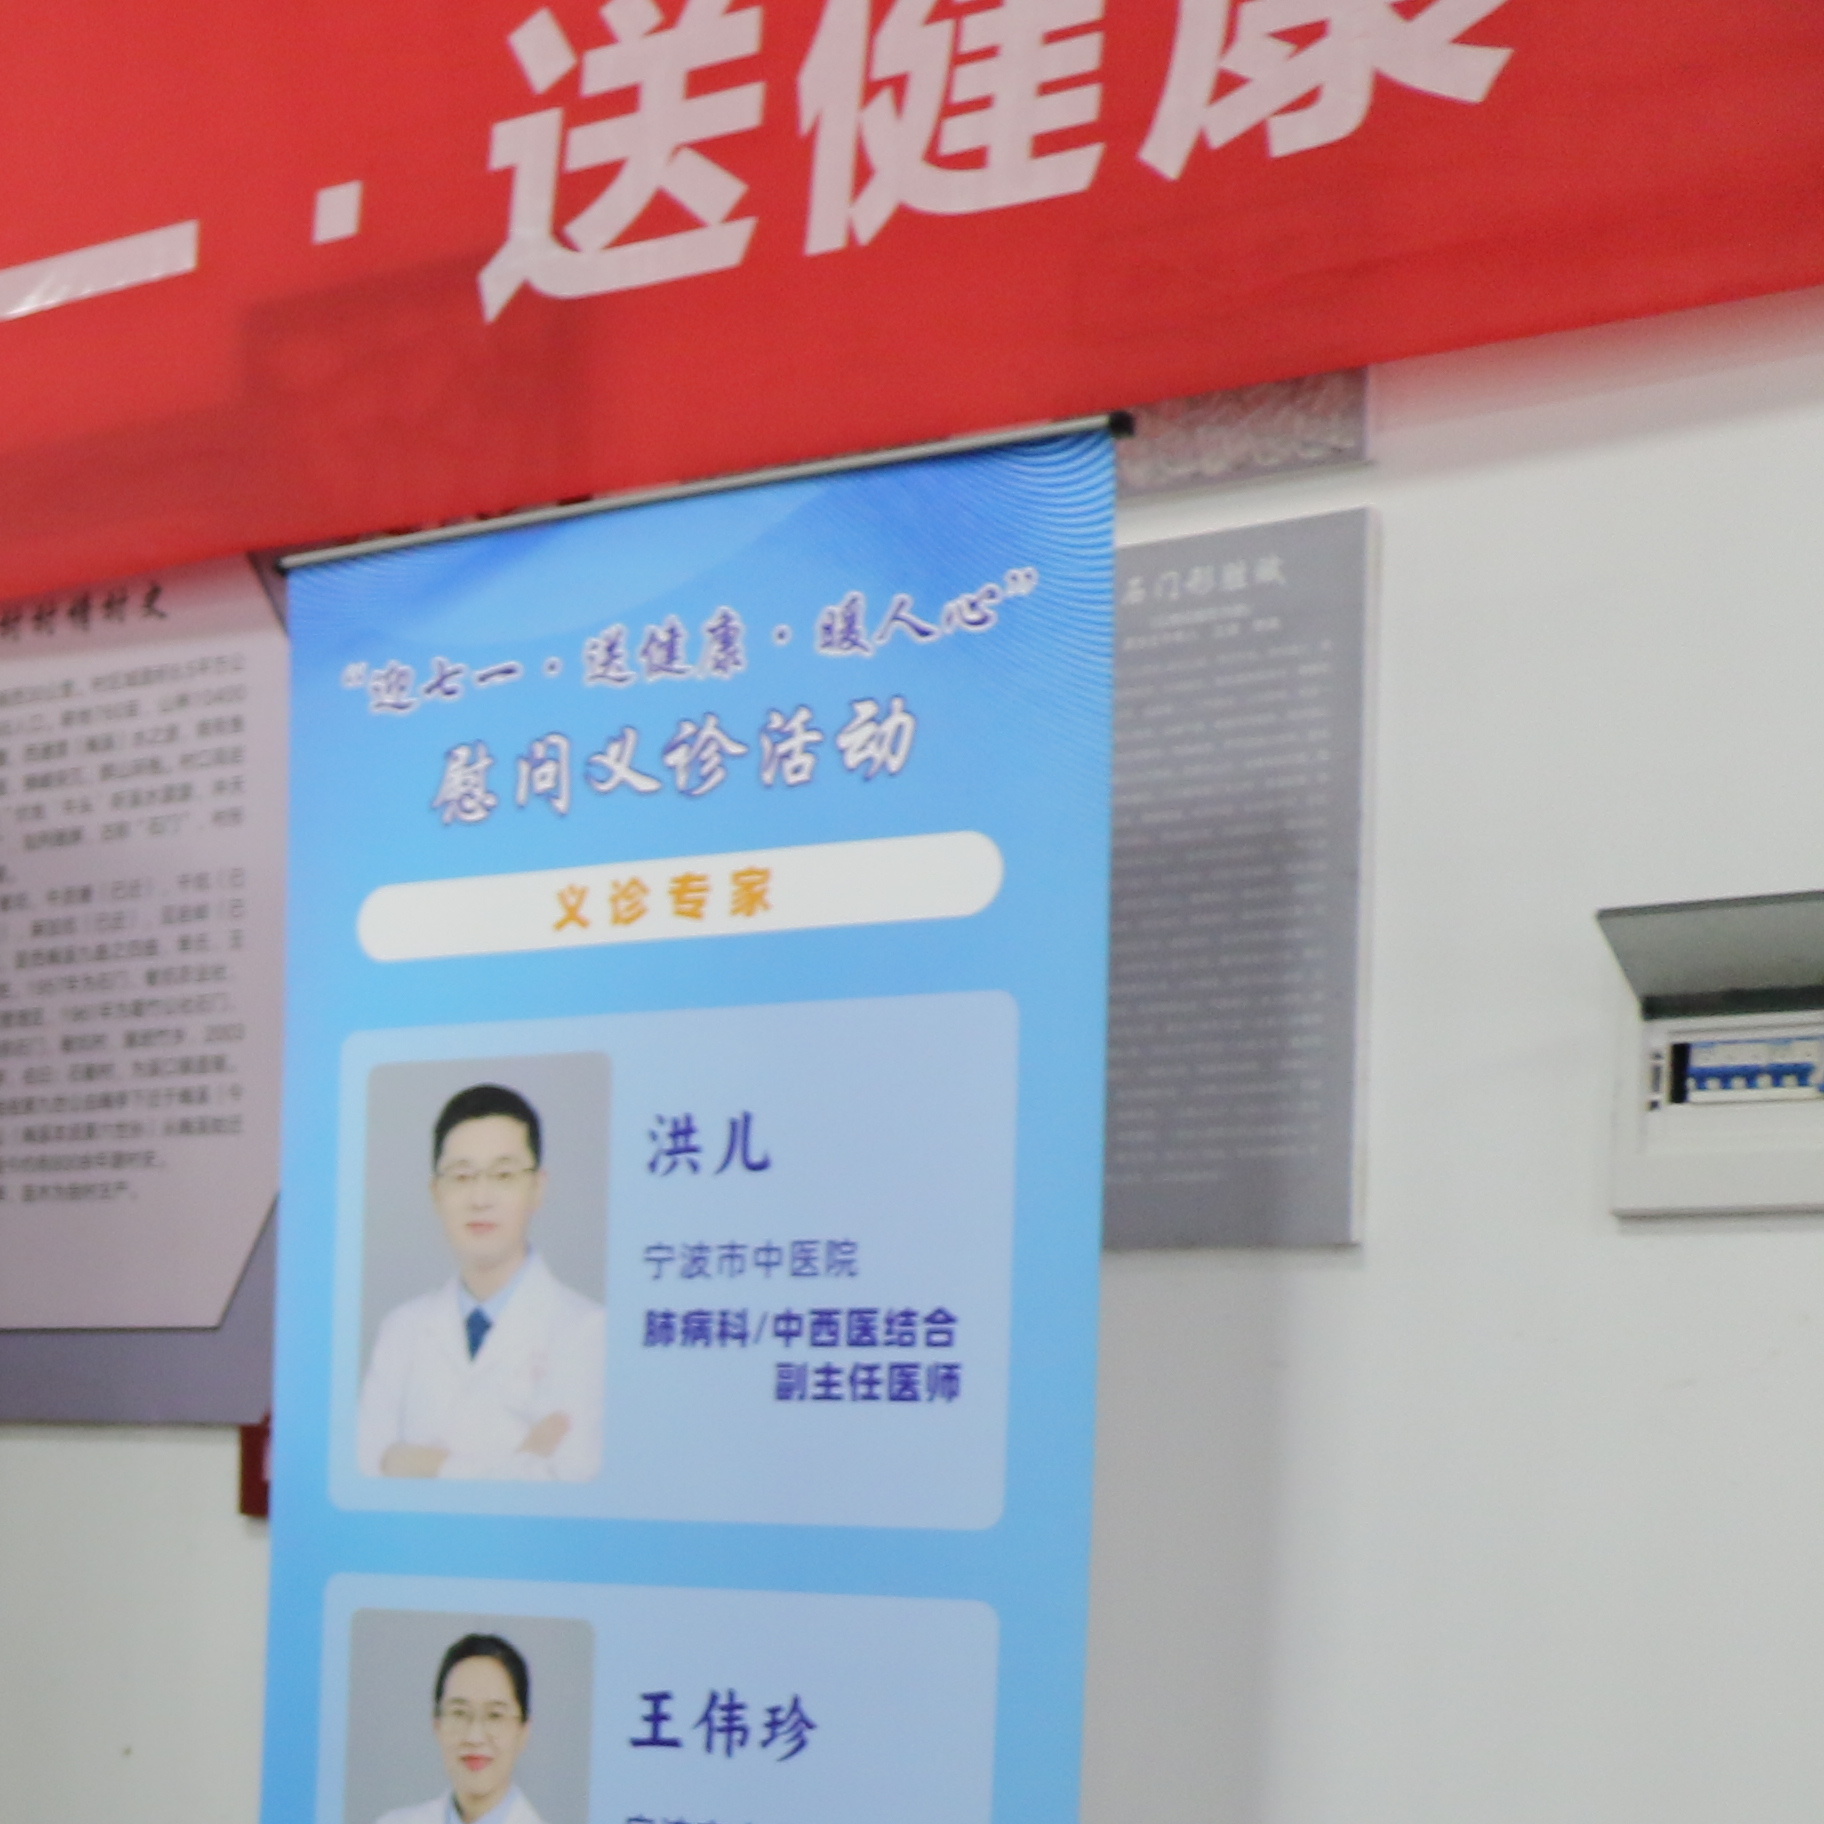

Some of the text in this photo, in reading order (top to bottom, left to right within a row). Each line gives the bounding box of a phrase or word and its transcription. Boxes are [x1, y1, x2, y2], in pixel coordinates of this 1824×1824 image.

[342, 566, 1038, 712] “迎七一·送健康·暖人心”
[433, 695, 917, 825] 慰问义诊活动
[553, 867, 772, 931] 义诊专家
[648, 1110, 771, 1177] 洪儿
[644, 1238, 859, 1281] 宁波市中医院
[642, 1306, 958, 1349] 肺病科/中西医结合
[775, 1361, 963, 1403] 副主任医师
[628, 1687, 818, 1762] 王伟珍
